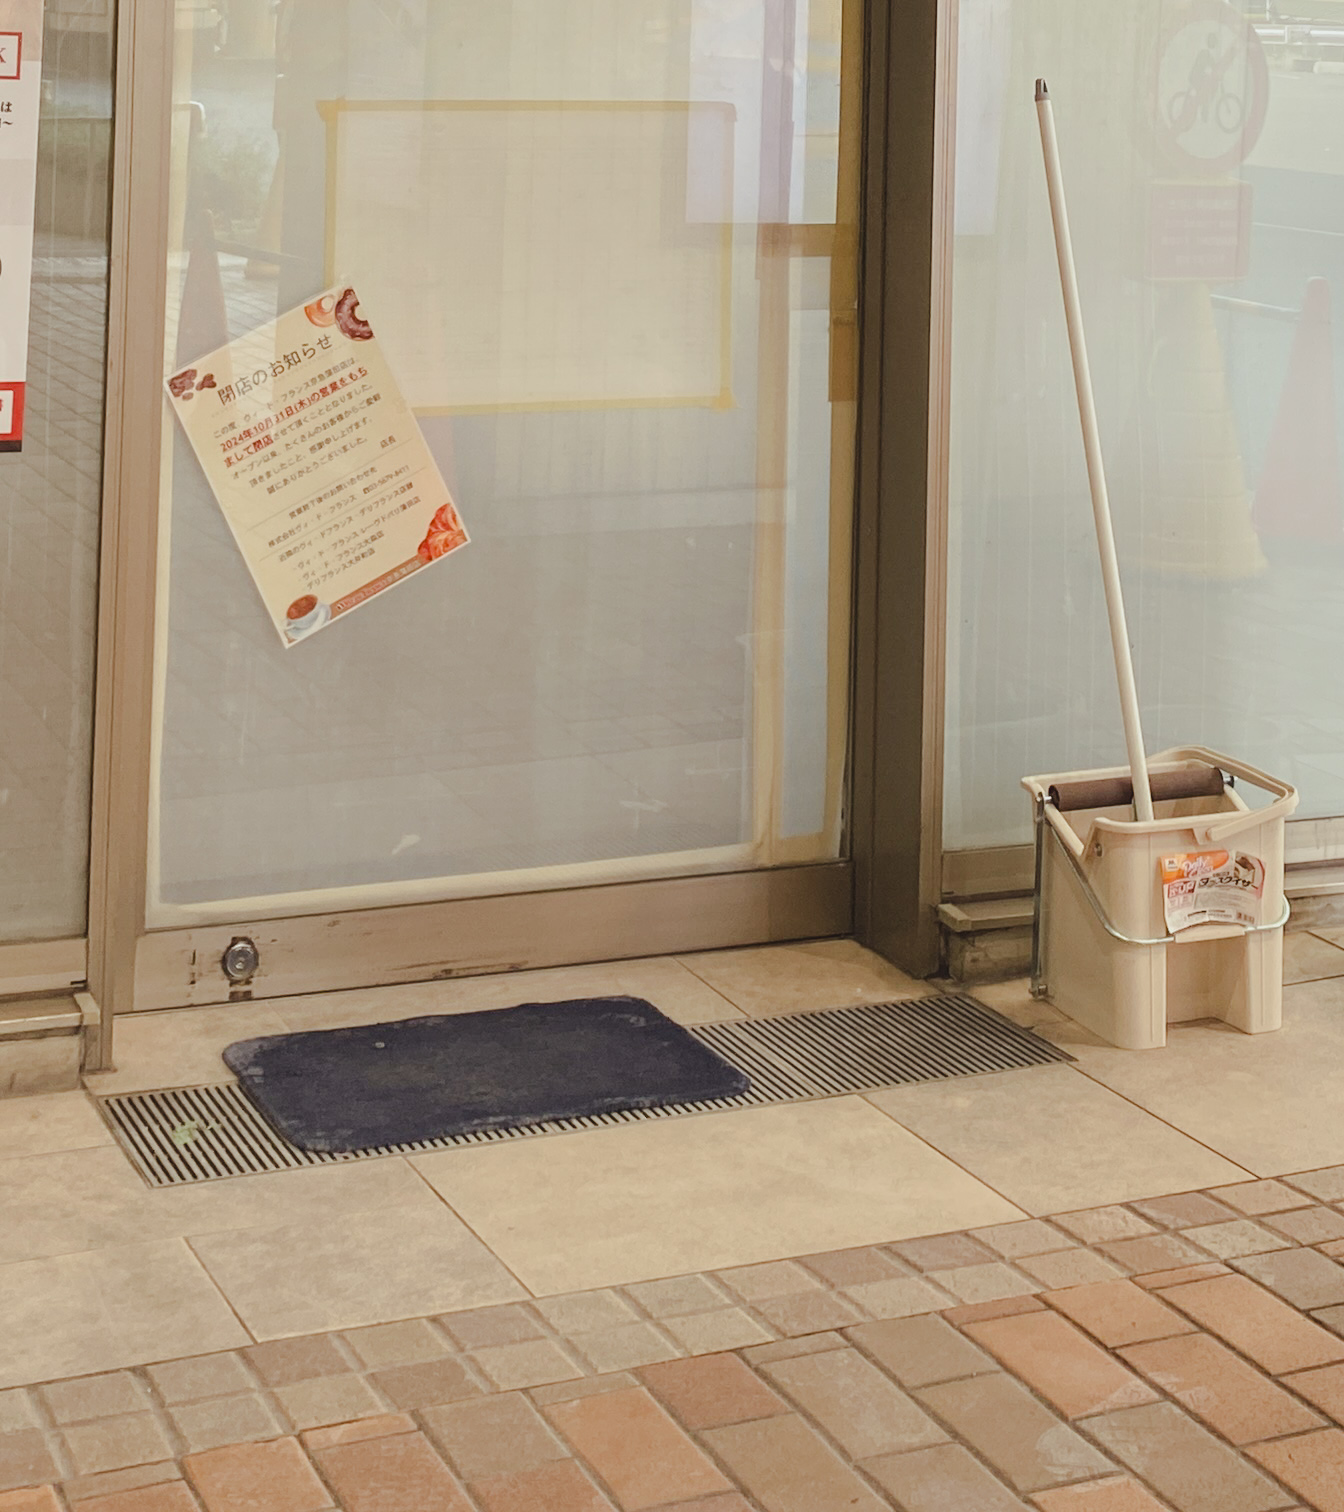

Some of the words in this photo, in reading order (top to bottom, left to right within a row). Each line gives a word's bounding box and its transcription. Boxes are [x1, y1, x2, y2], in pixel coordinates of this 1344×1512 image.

[216, 331, 334, 405] 閉店のお知らせ
[379, 434, 396, 449] 店長
